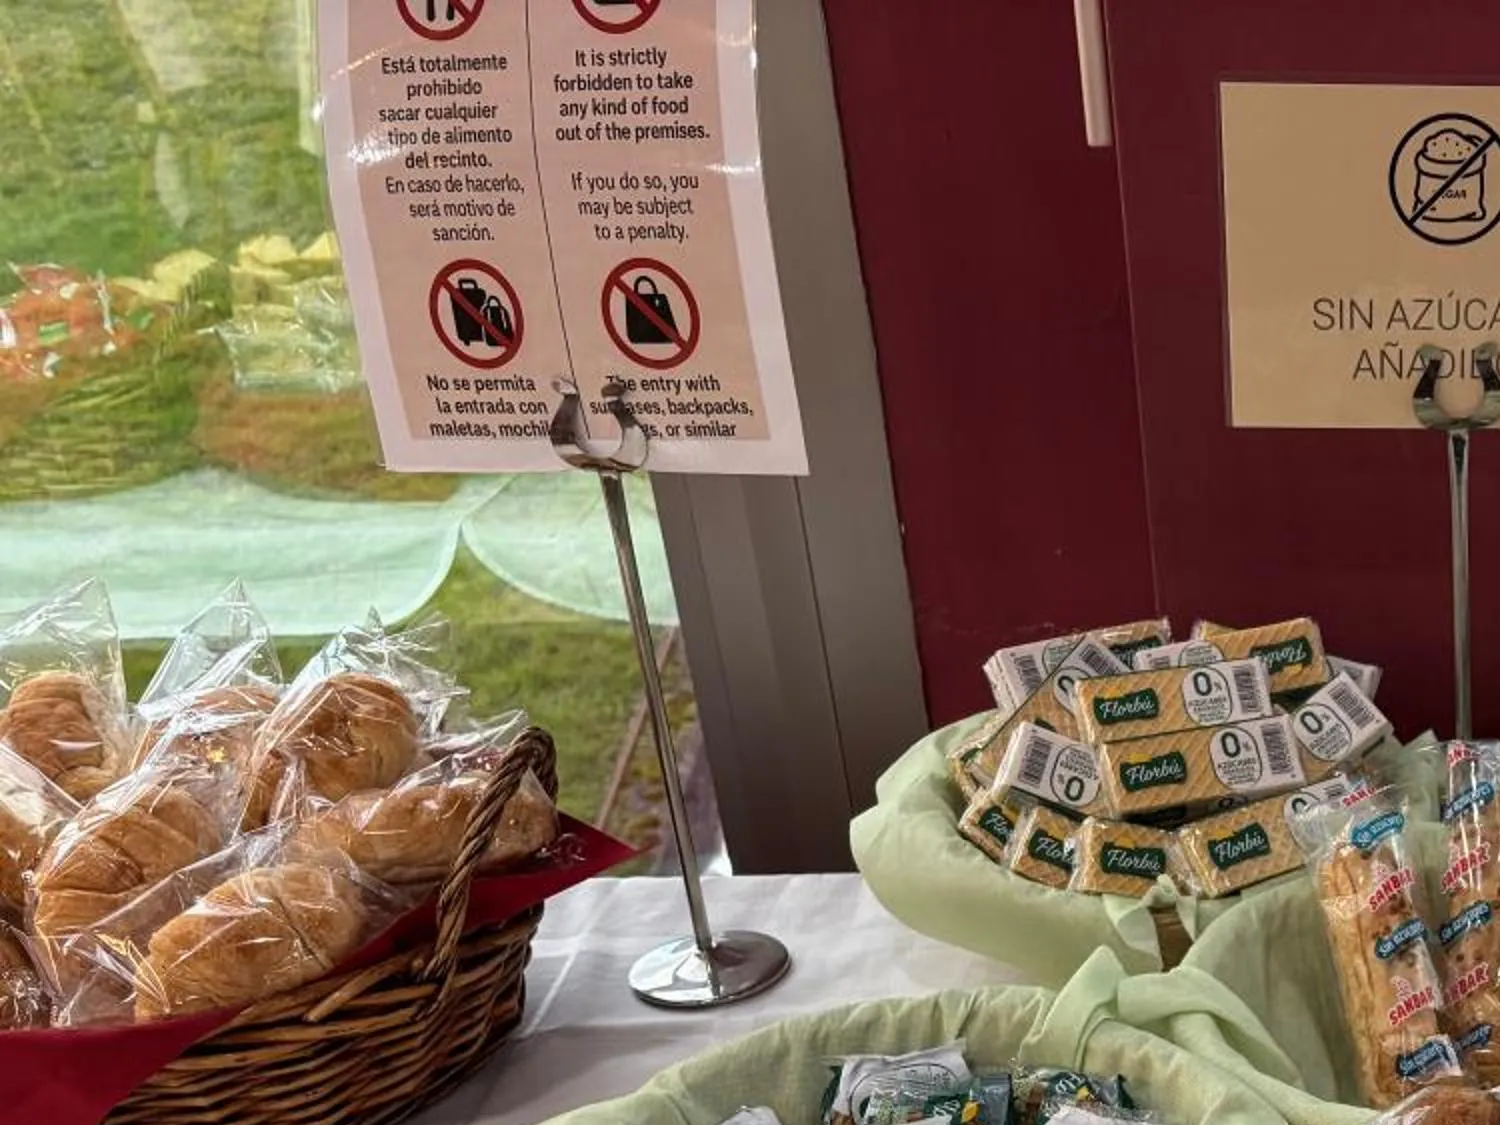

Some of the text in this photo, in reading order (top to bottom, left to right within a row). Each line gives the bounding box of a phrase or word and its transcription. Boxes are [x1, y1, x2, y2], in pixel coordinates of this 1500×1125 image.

[382, 54, 507, 74] Está totalmente
[575, 49, 667, 69] It is strictly
[407, 78, 482, 100] prohibido
[554, 73, 693, 92] forbidden to take
[380, 103, 498, 121] sacar cualquier
[560, 96, 688, 118] any kind of food
[388, 128, 512, 146] tipo de alimento
[556, 122, 710, 143] out of the premises.
[405, 151, 492, 168] del recinto.
[386, 175, 525, 194] En caso de hacerlo,
[572, 172, 698, 193] If you do so, you
[410, 199, 515, 216] será motivo de
[579, 197, 693, 218] may be subject
[433, 223, 495, 242] sanción.
[594, 221, 689, 243] to a penalty.
[1313, 297, 1373, 331] SIN
[428, 375, 535, 394] No se permita
[641, 377, 682, 394] entry
[685, 374, 721, 391] with
[436, 398, 548, 414] la entrada con
[667, 398, 753, 416] backpacks,
[430, 421, 551, 439] maletas, mochil
[666, 421, 736, 437] or similar
[1099, 696, 1154, 718] Florbú
[1126, 758, 1184, 784] Florbú
[1214, 831, 1265, 862] Florbú
